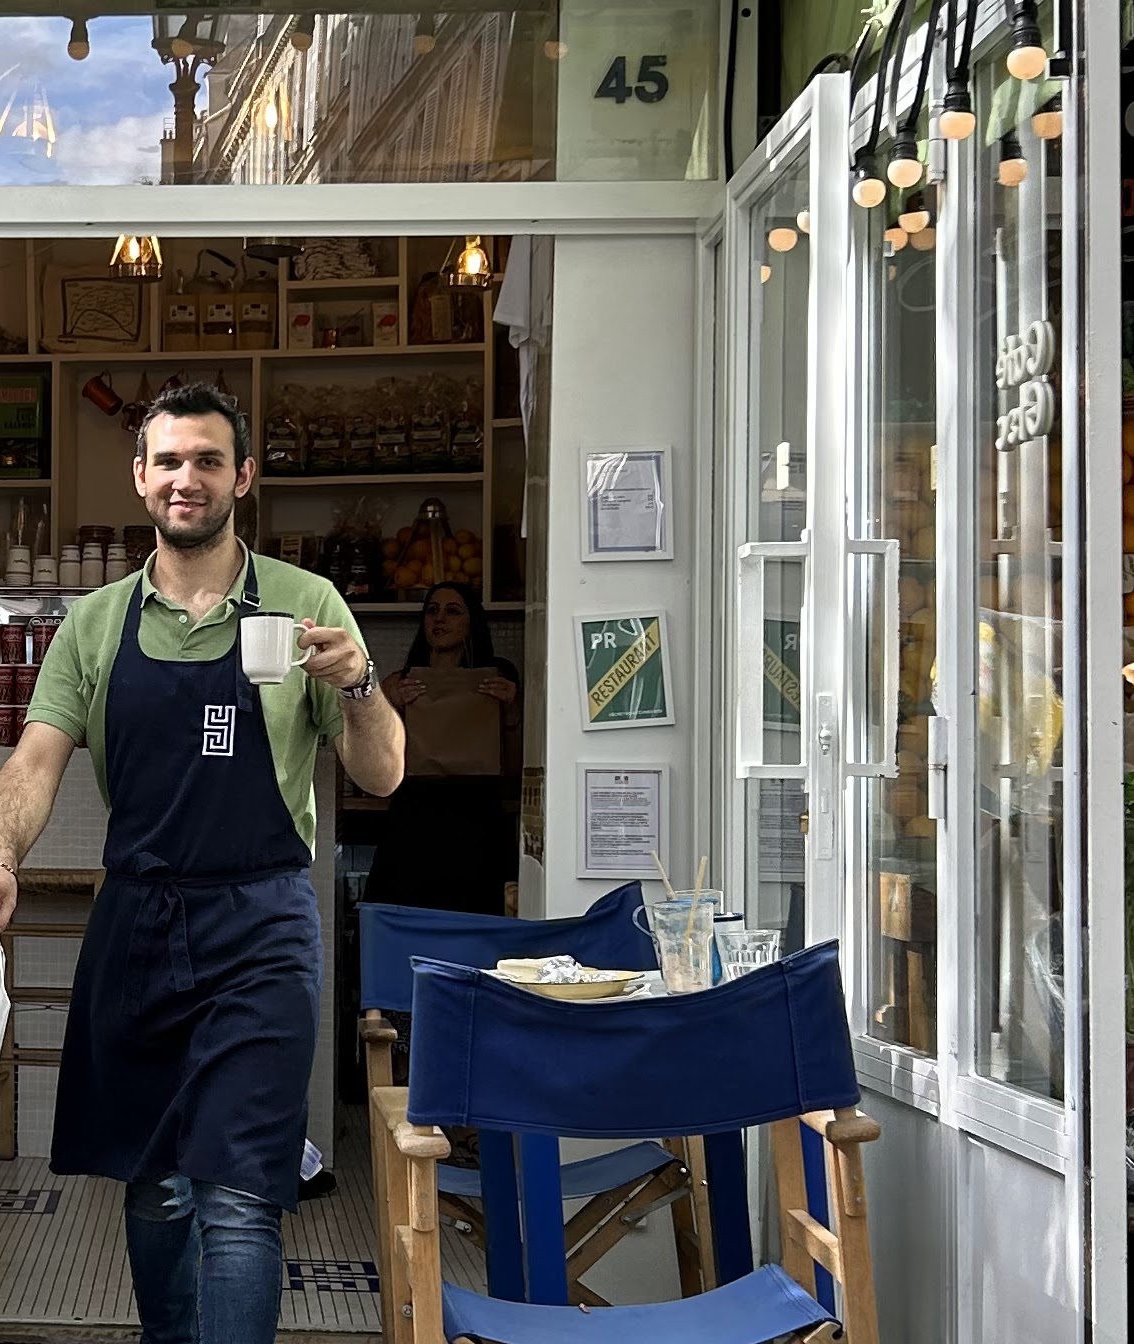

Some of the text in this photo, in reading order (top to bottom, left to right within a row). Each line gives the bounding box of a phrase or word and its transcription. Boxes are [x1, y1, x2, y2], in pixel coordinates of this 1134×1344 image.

[594, 55, 669, 104] 45
[590, 632, 617, 650] PR
[590, 631, 657, 707] RESTAURANT
